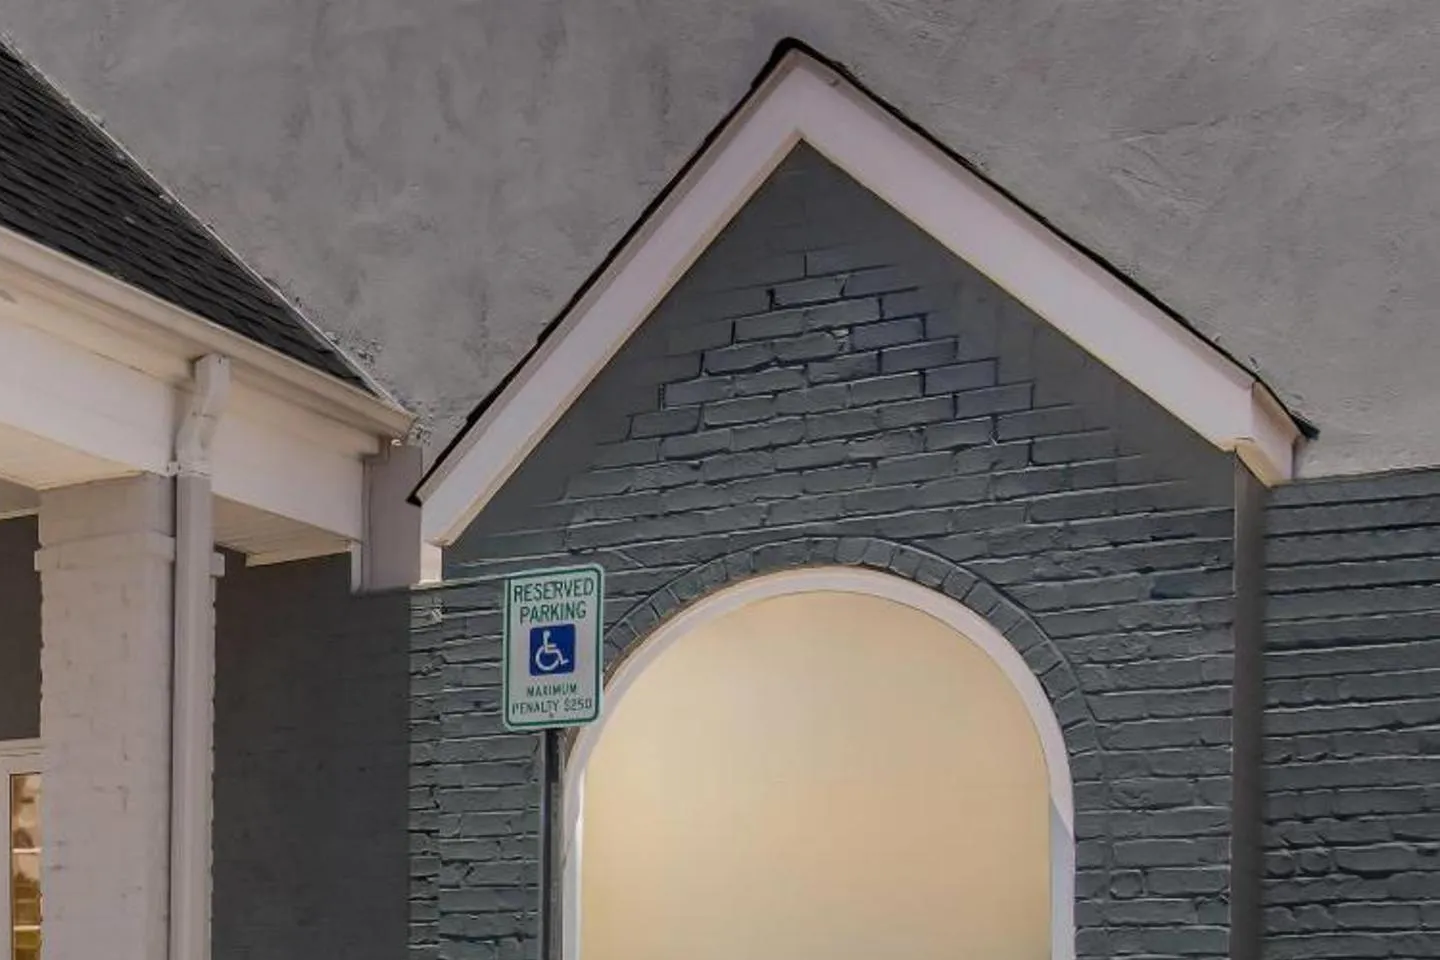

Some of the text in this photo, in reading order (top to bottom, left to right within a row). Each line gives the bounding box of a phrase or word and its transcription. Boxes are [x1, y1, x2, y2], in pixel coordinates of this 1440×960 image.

[514, 578, 594, 602] RESERVED
[520, 601, 587, 624] PARKING
[526, 683, 577, 697] MAXIMUM
[512, 700, 559, 715] PENALTY
